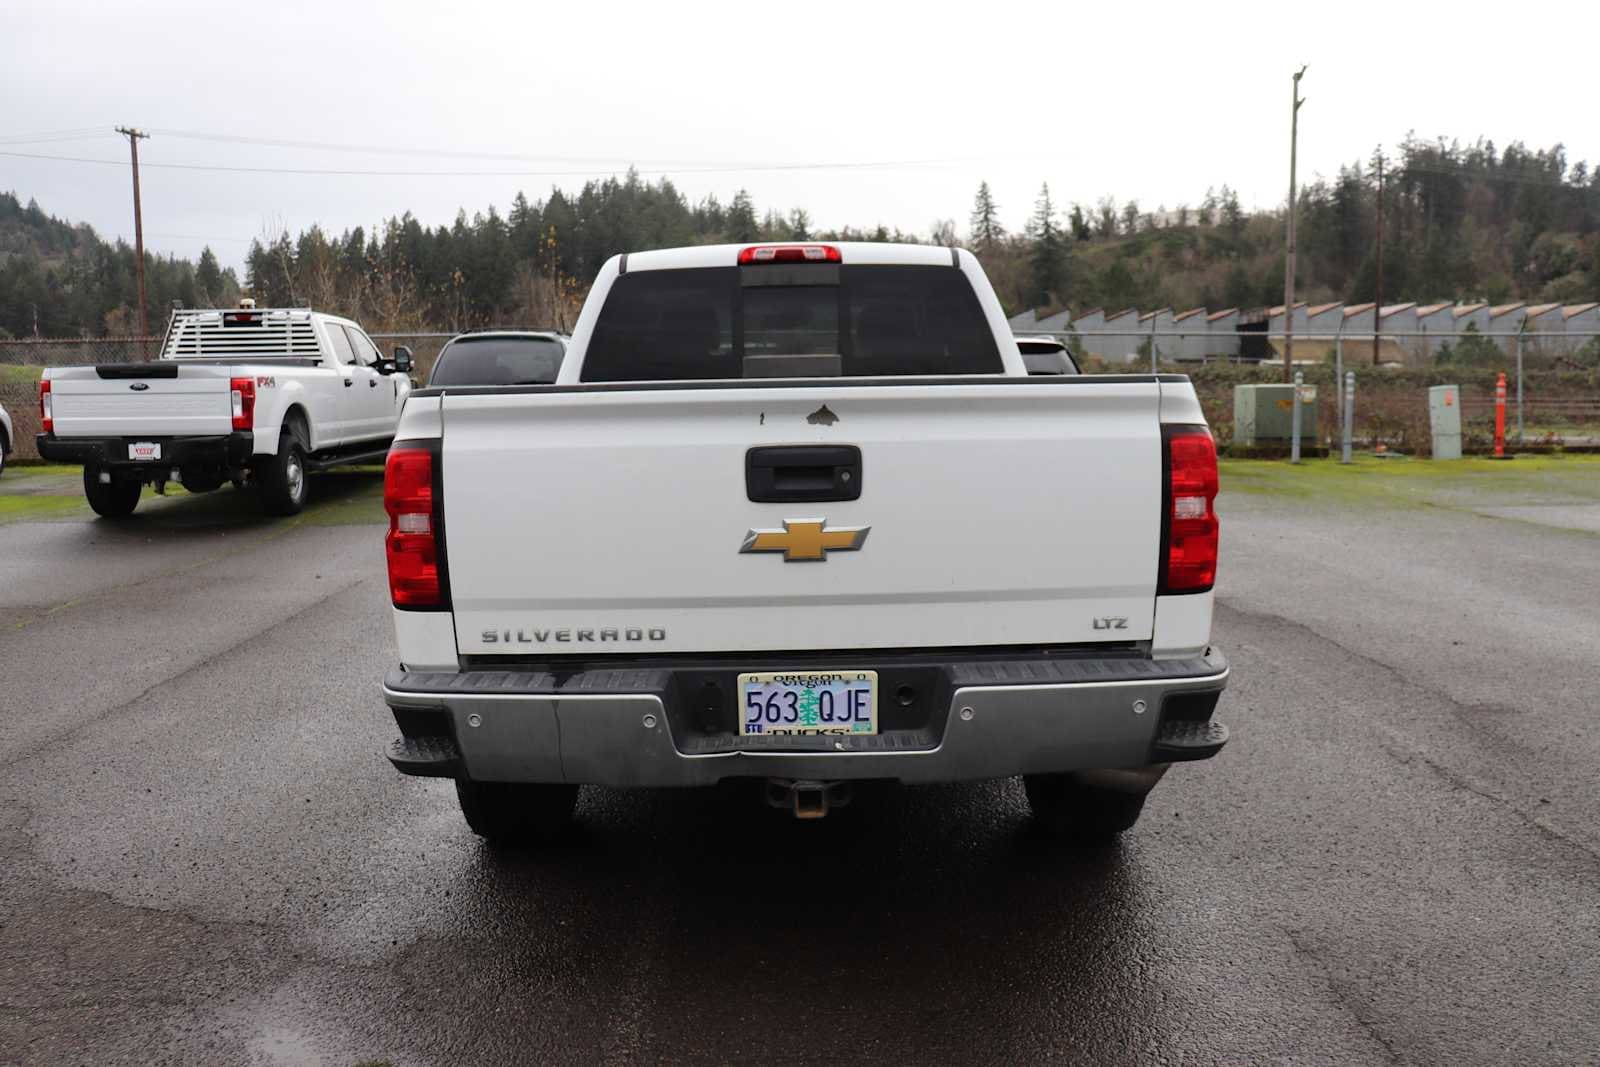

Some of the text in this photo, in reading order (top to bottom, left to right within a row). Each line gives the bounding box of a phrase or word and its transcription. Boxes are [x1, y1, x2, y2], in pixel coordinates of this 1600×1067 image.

[1092, 616, 1129, 630] LTZ
[482, 629, 666, 643] SILVERADO
[746, 689, 870, 723] 563 QJE
